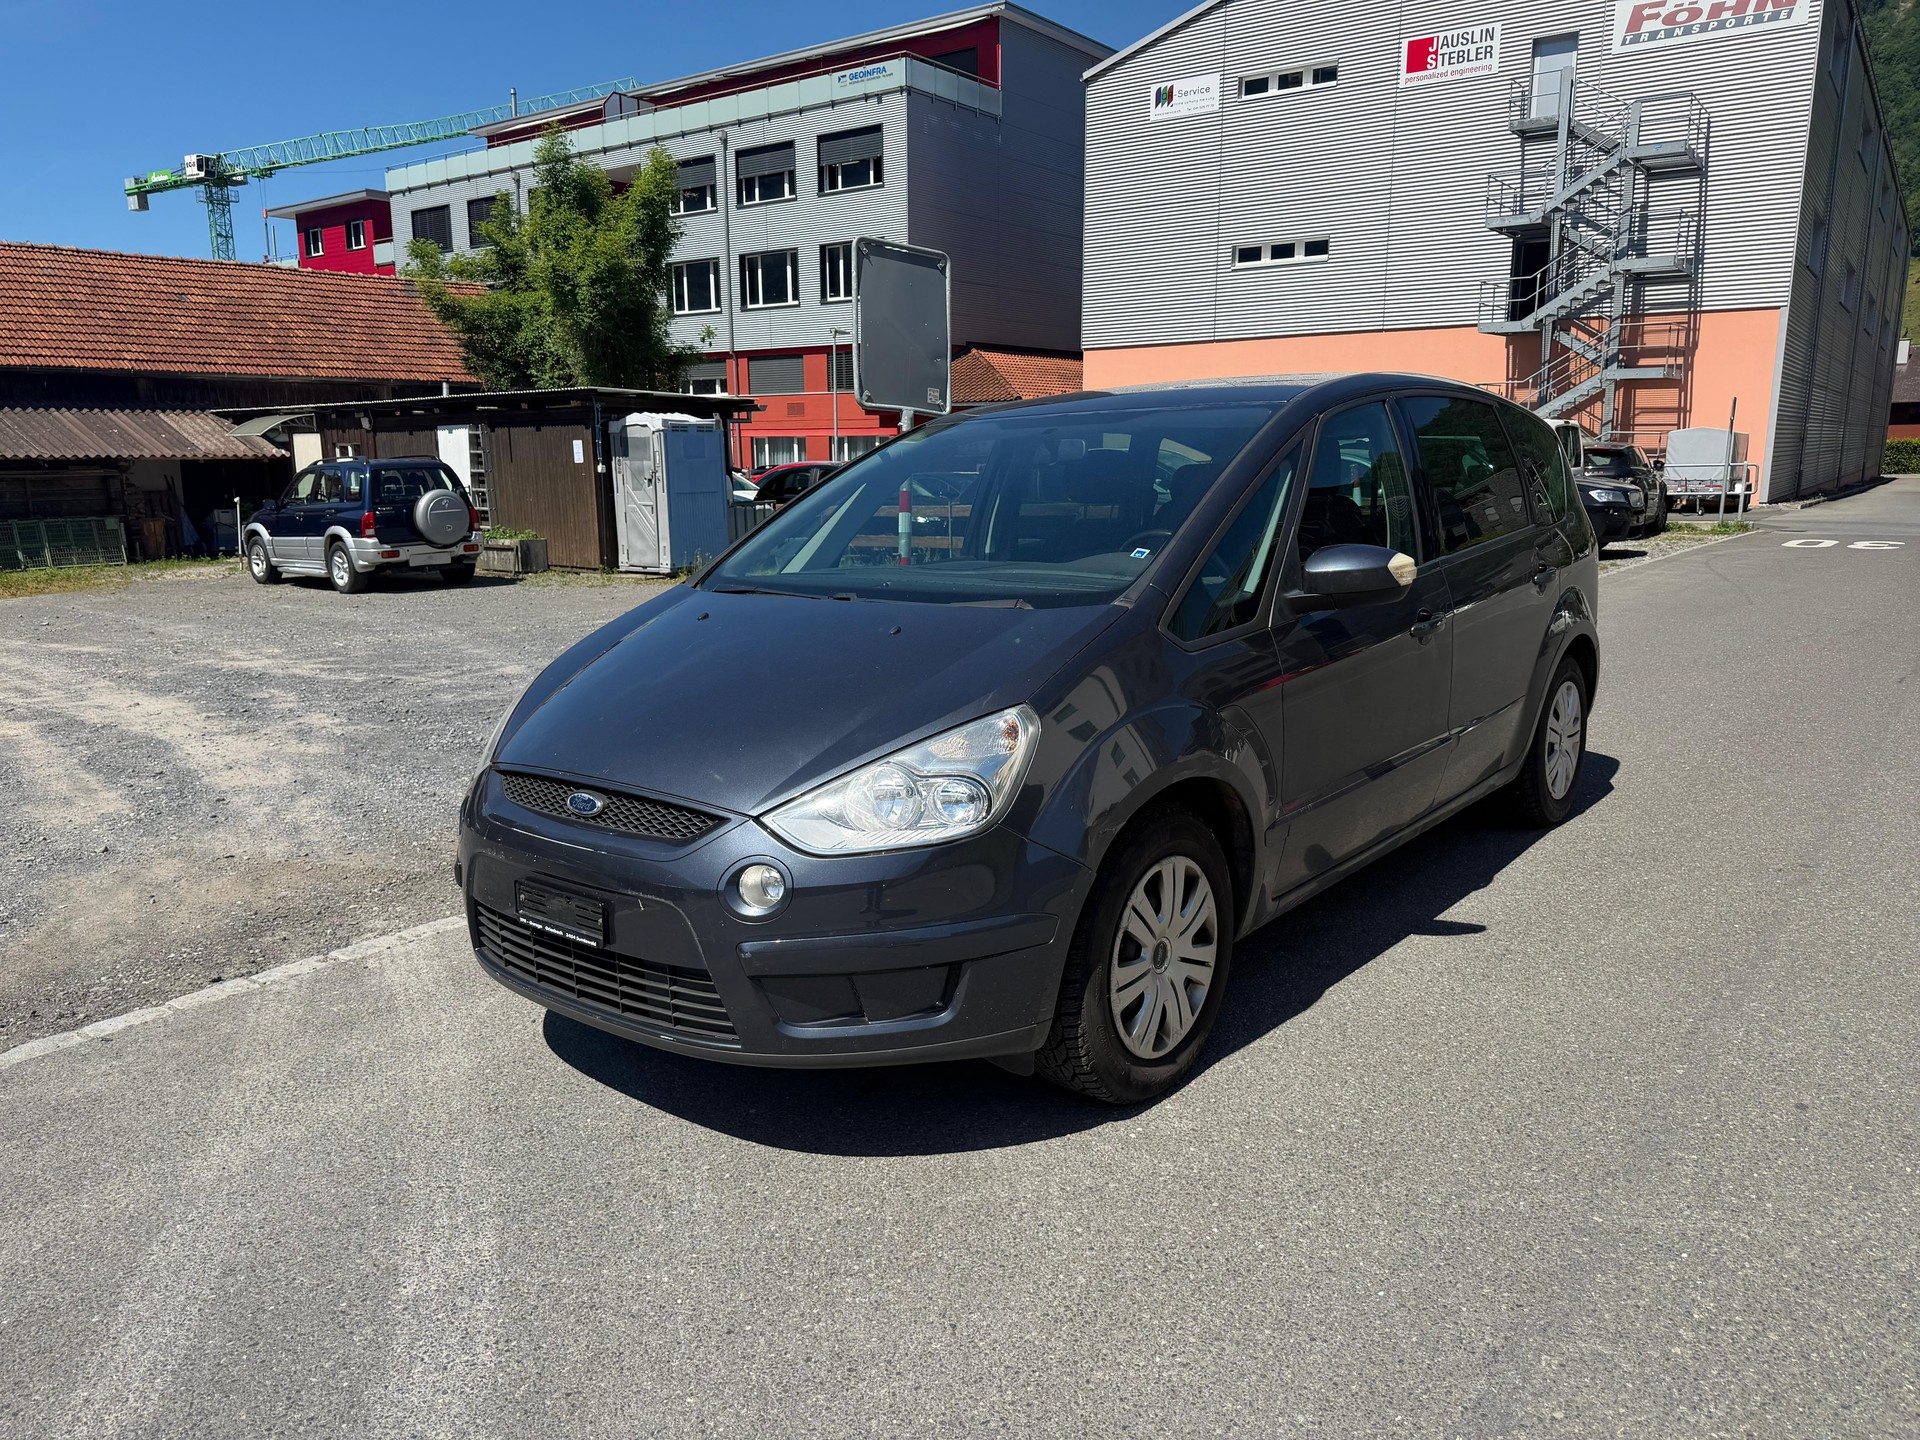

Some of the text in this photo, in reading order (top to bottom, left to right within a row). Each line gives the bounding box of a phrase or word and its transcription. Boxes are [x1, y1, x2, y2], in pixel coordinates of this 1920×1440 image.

[1624, 9, 1790, 45] TRANSPORTE
[1428, 27, 1495, 52] JAUSLIN
[1426, 45, 1494, 69] STEBLER
[848, 66, 887, 81] GEOINFRA
[1404, 64, 1493, 85] personalized engineering
[572, 795, 593, 810] Ford
